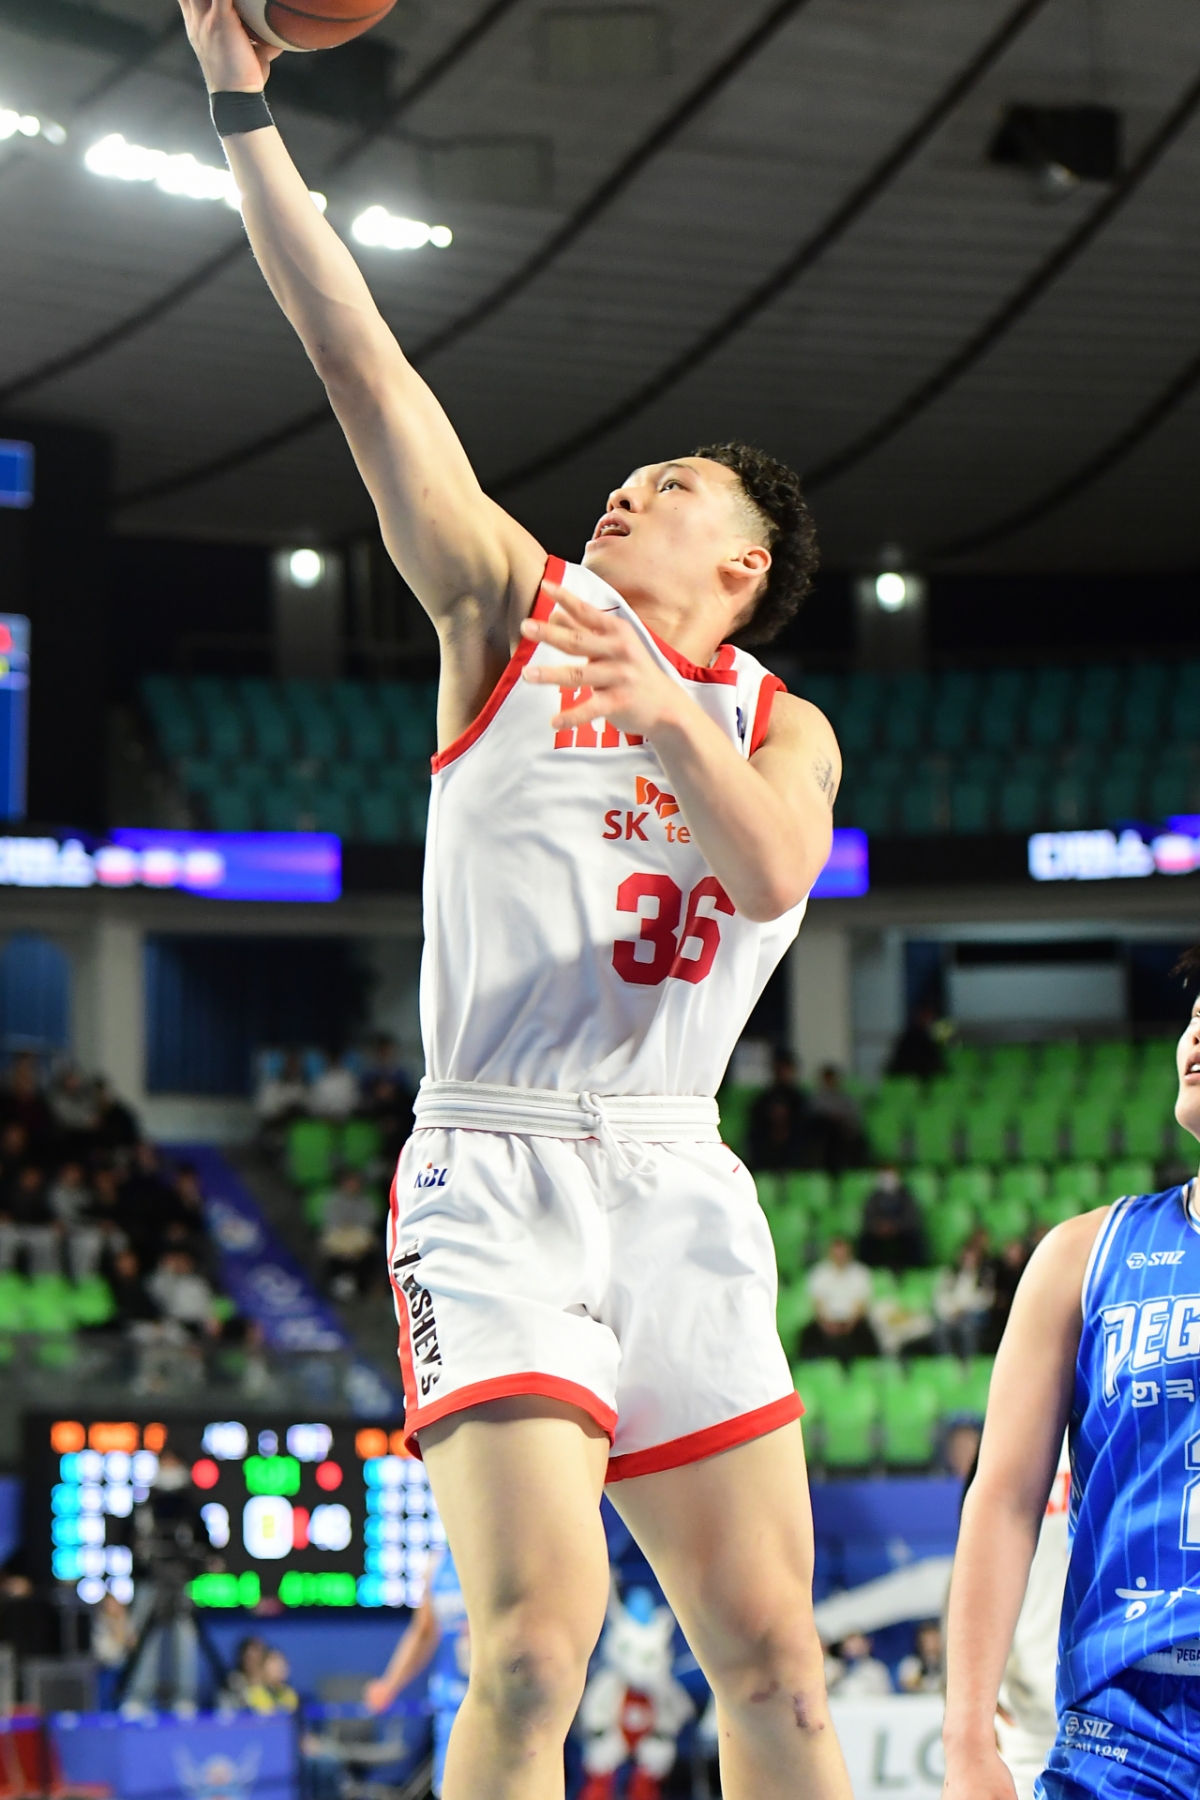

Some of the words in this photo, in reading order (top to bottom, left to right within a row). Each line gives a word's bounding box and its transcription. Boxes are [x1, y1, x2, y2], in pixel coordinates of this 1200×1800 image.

[602, 809, 649, 841] SK
[612, 872, 736, 985] 36
[413, 1168, 448, 1188] KBL
[394, 1239, 442, 1396] HRSHEY'S
